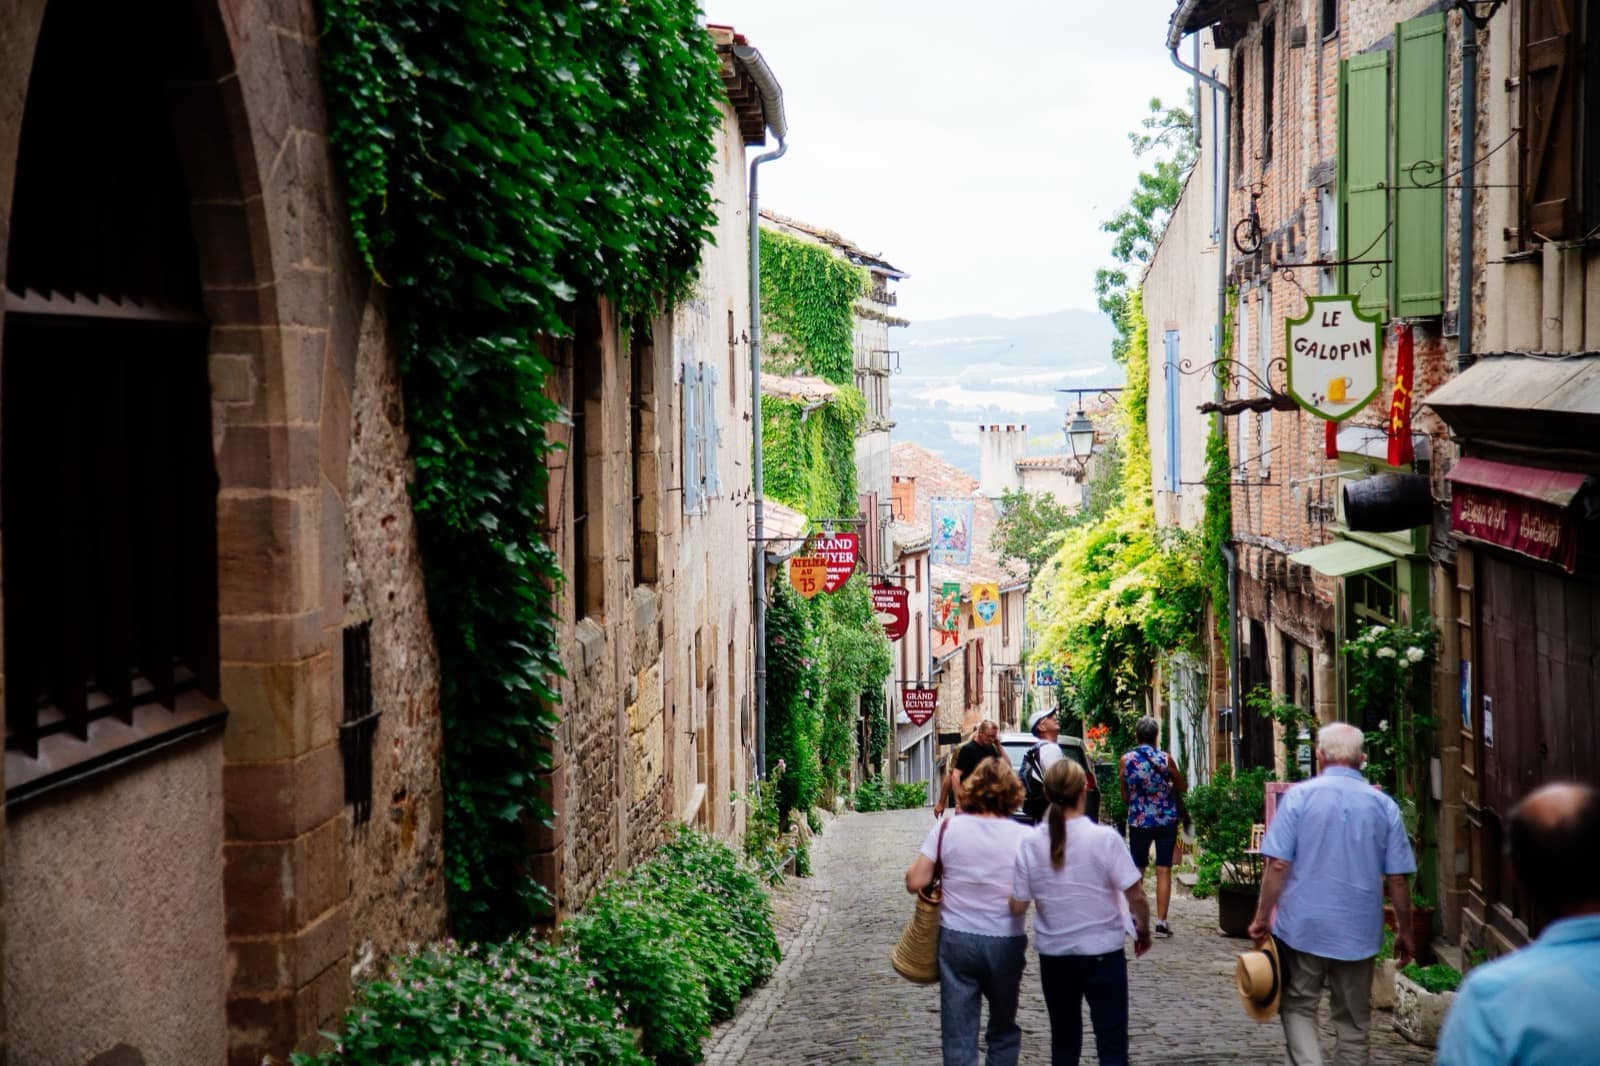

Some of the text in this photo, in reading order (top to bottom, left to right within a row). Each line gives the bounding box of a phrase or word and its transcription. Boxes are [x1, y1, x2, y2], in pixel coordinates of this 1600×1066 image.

[1321, 311, 1341, 327] LE
[1294, 337, 1372, 360] GALOPIN
[815, 538, 853, 550] RAND
[791, 557, 826, 567] ATELIER
[800, 577, 816, 592] 15
[906, 692, 934, 700] GRAND
